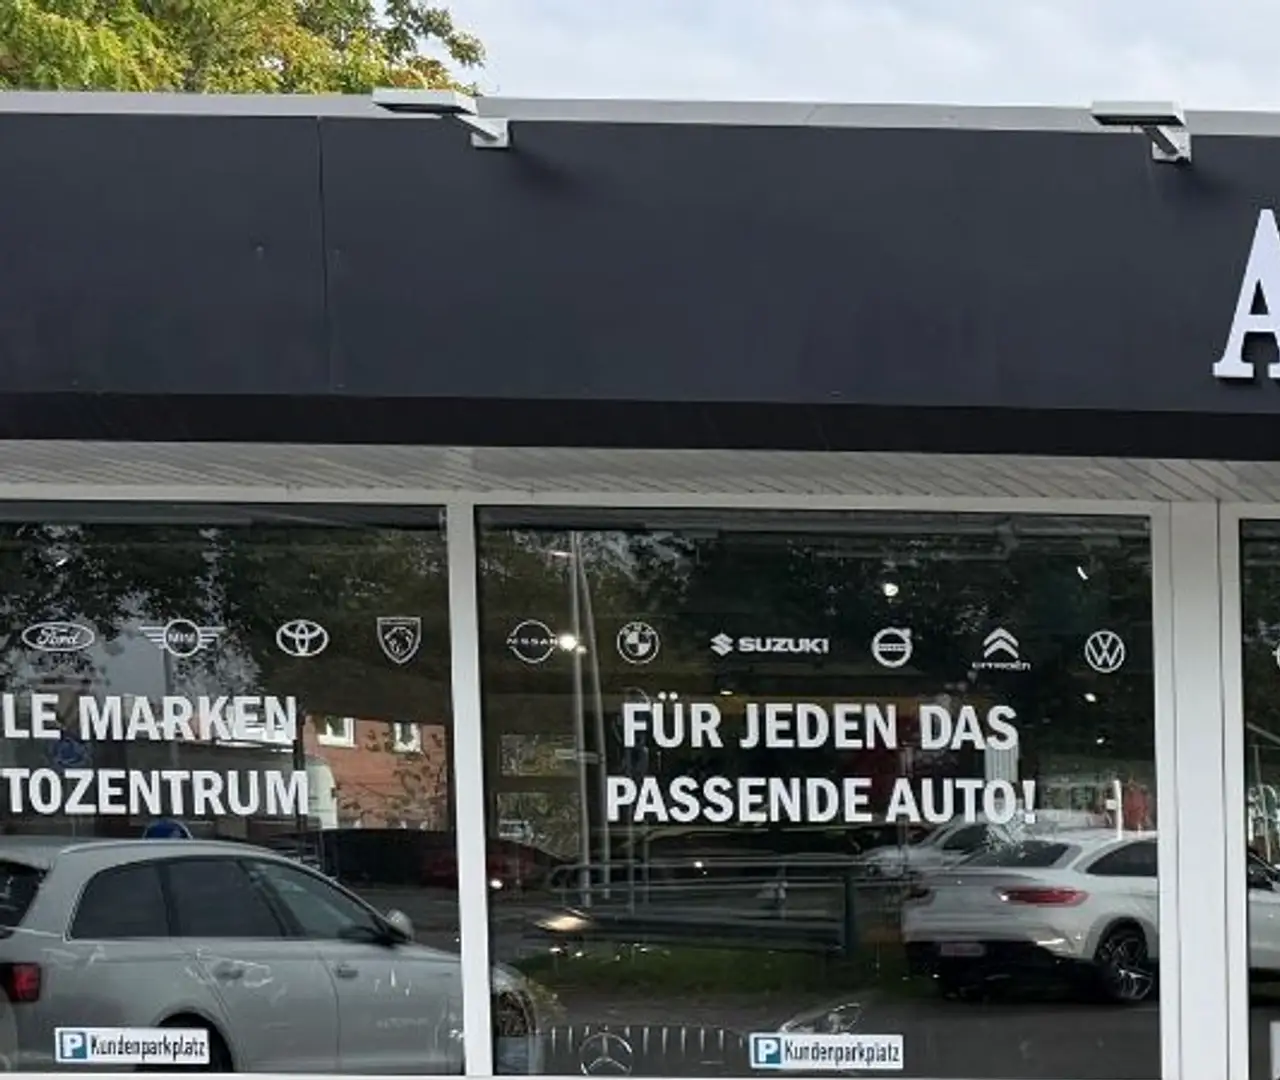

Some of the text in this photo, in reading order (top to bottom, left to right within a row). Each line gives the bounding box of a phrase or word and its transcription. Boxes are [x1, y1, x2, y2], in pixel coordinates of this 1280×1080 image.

[738, 636, 829, 654] SUZUKI
[2, 693, 297, 741] LE MARKEN
[623, 691, 1019, 750] FÜR JEDEN DAS
[0, 767, 309, 815] TOZENTRUM
[606, 776, 1036, 824] PASSENDE AUTO!
[91, 1035, 205, 1060] Kundenparkplatz
[785, 1040, 900, 1065] Kundenparkplatz
